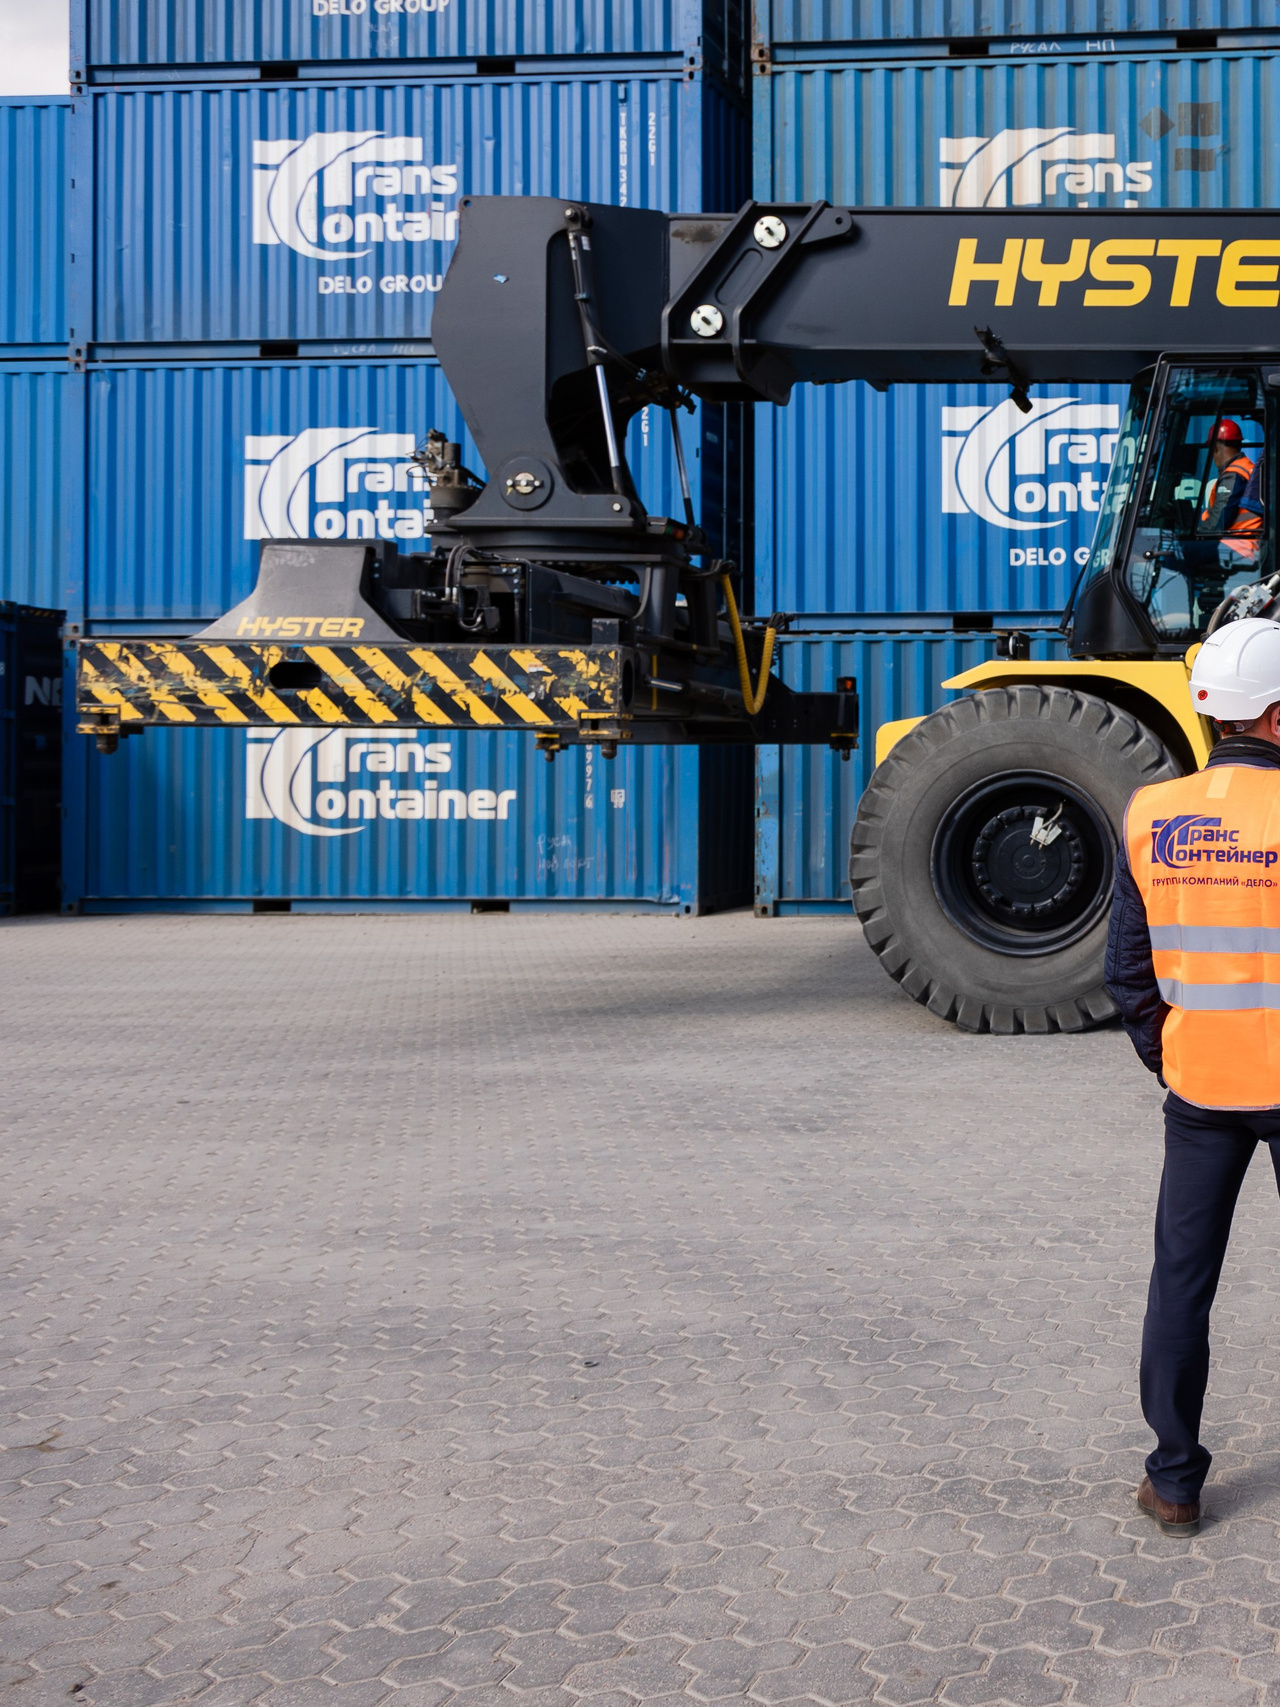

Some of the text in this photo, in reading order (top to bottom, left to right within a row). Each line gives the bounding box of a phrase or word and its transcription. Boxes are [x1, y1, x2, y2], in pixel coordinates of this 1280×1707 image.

[312, 0, 449, 16] DELO GROUP
[648, 111, 657, 166] 22G1
[253, 130, 458, 207] Trans
[940, 127, 1153, 206] Trans
[318, 274, 443, 294] DELO GROU
[1010, 547, 1067, 567] DELO
[235, 616, 365, 638] HYSTER
[245, 728, 452, 782] Trans
[1151, 814, 1240, 846] Транс
[1182, 876, 1239, 886] КОМПАНИЙ
